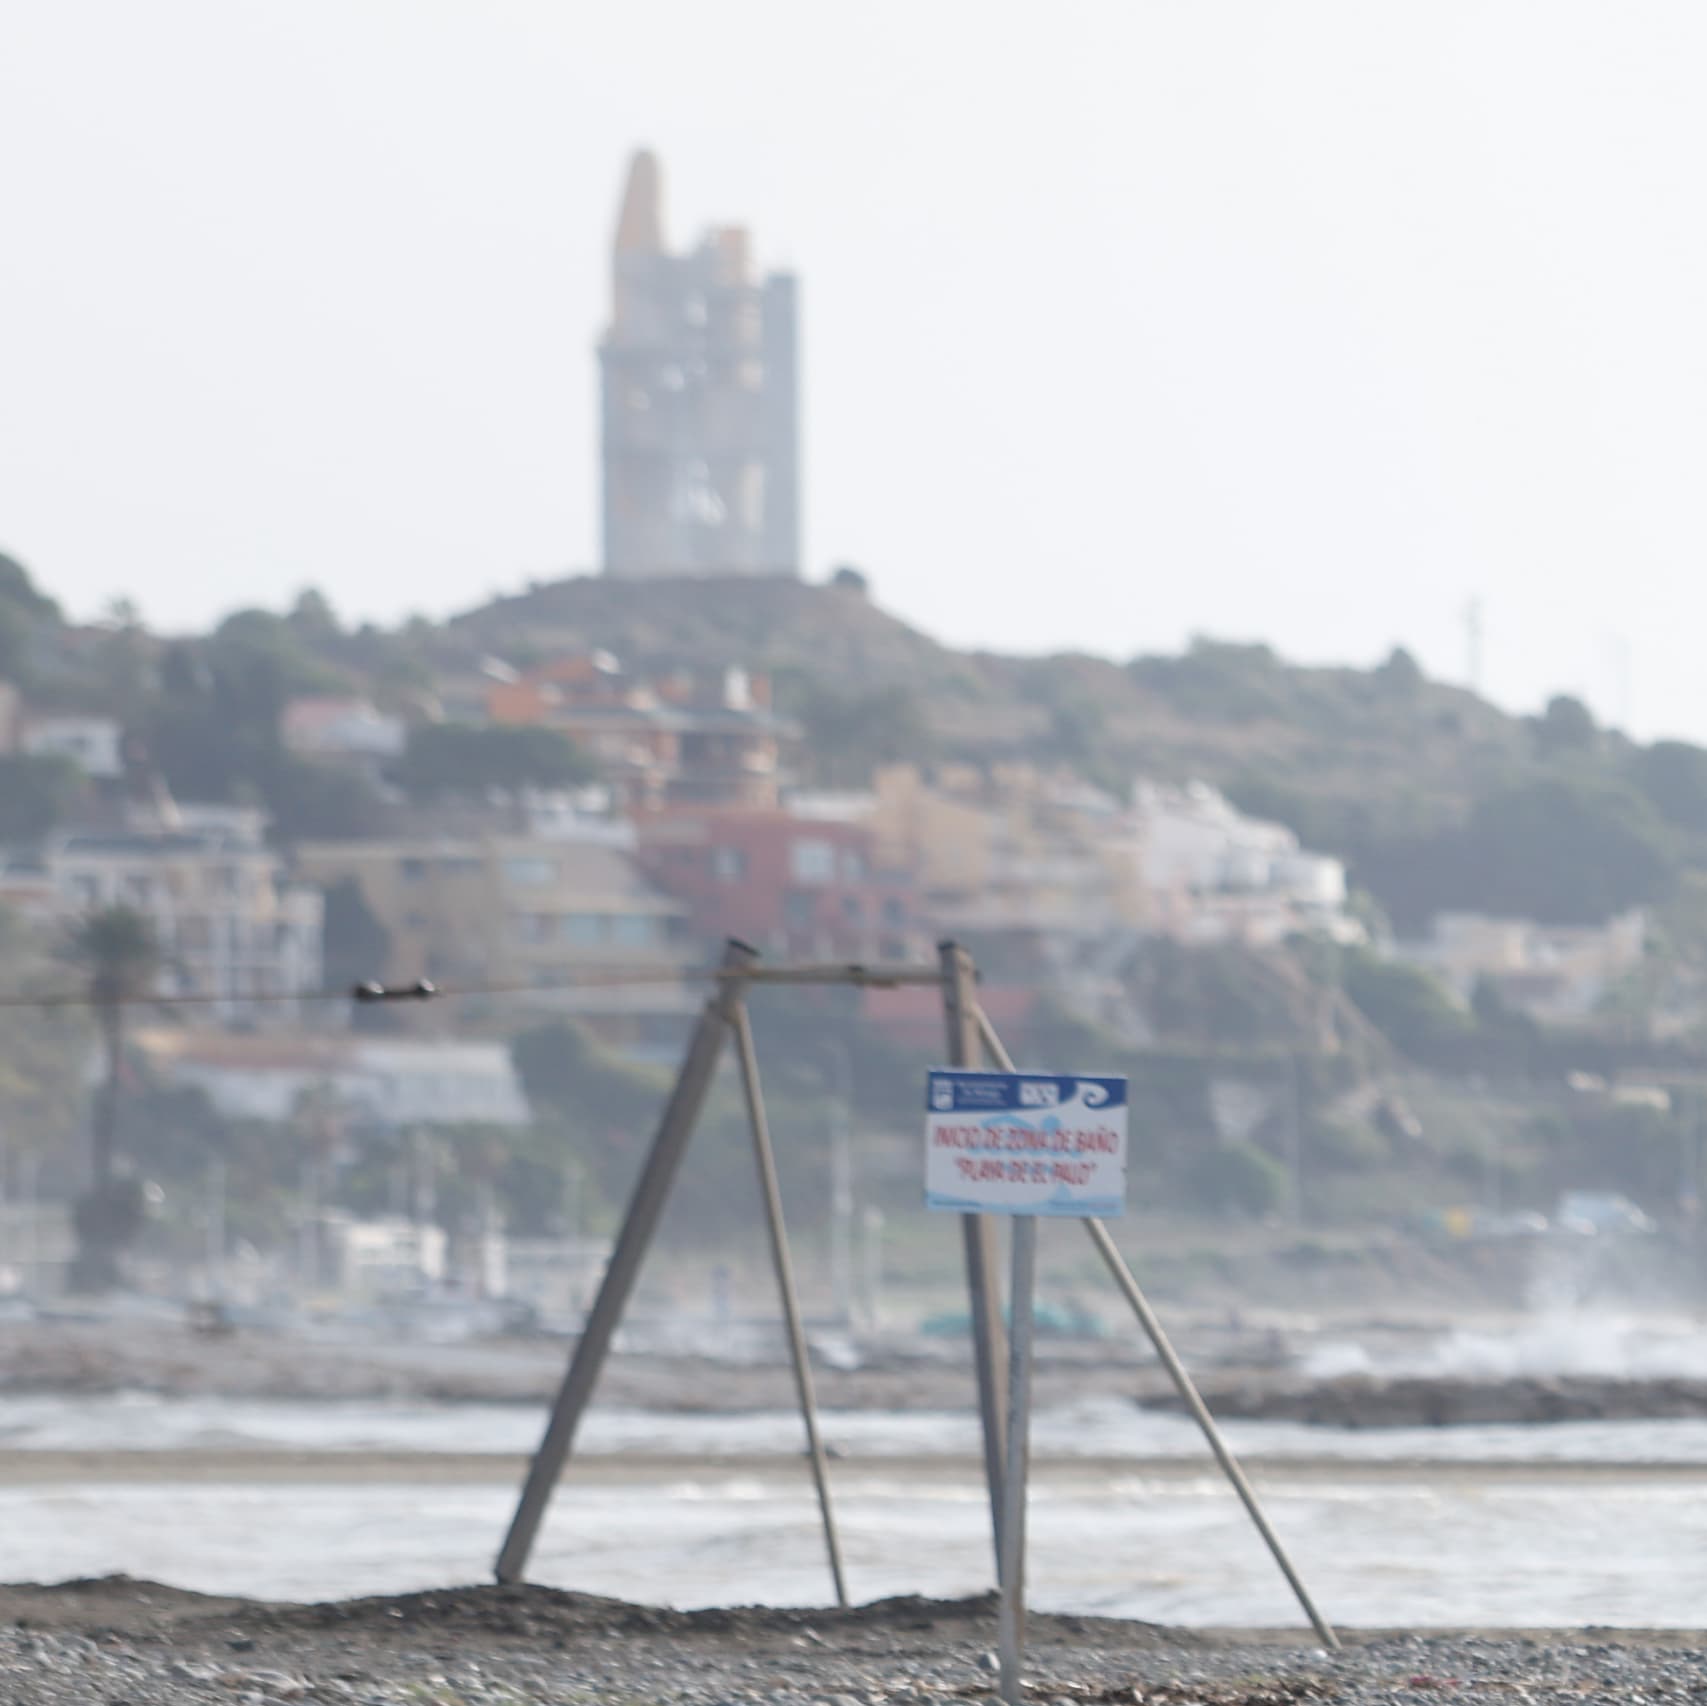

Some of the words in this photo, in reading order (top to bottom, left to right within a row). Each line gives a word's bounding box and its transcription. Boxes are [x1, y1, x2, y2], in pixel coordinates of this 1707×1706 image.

[986, 1128, 1003, 1150] DE
[1006, 1128, 1048, 1151] ZONA
[1053, 1130, 1072, 1152] DE
[1076, 1124, 1120, 1154] BAÑO
